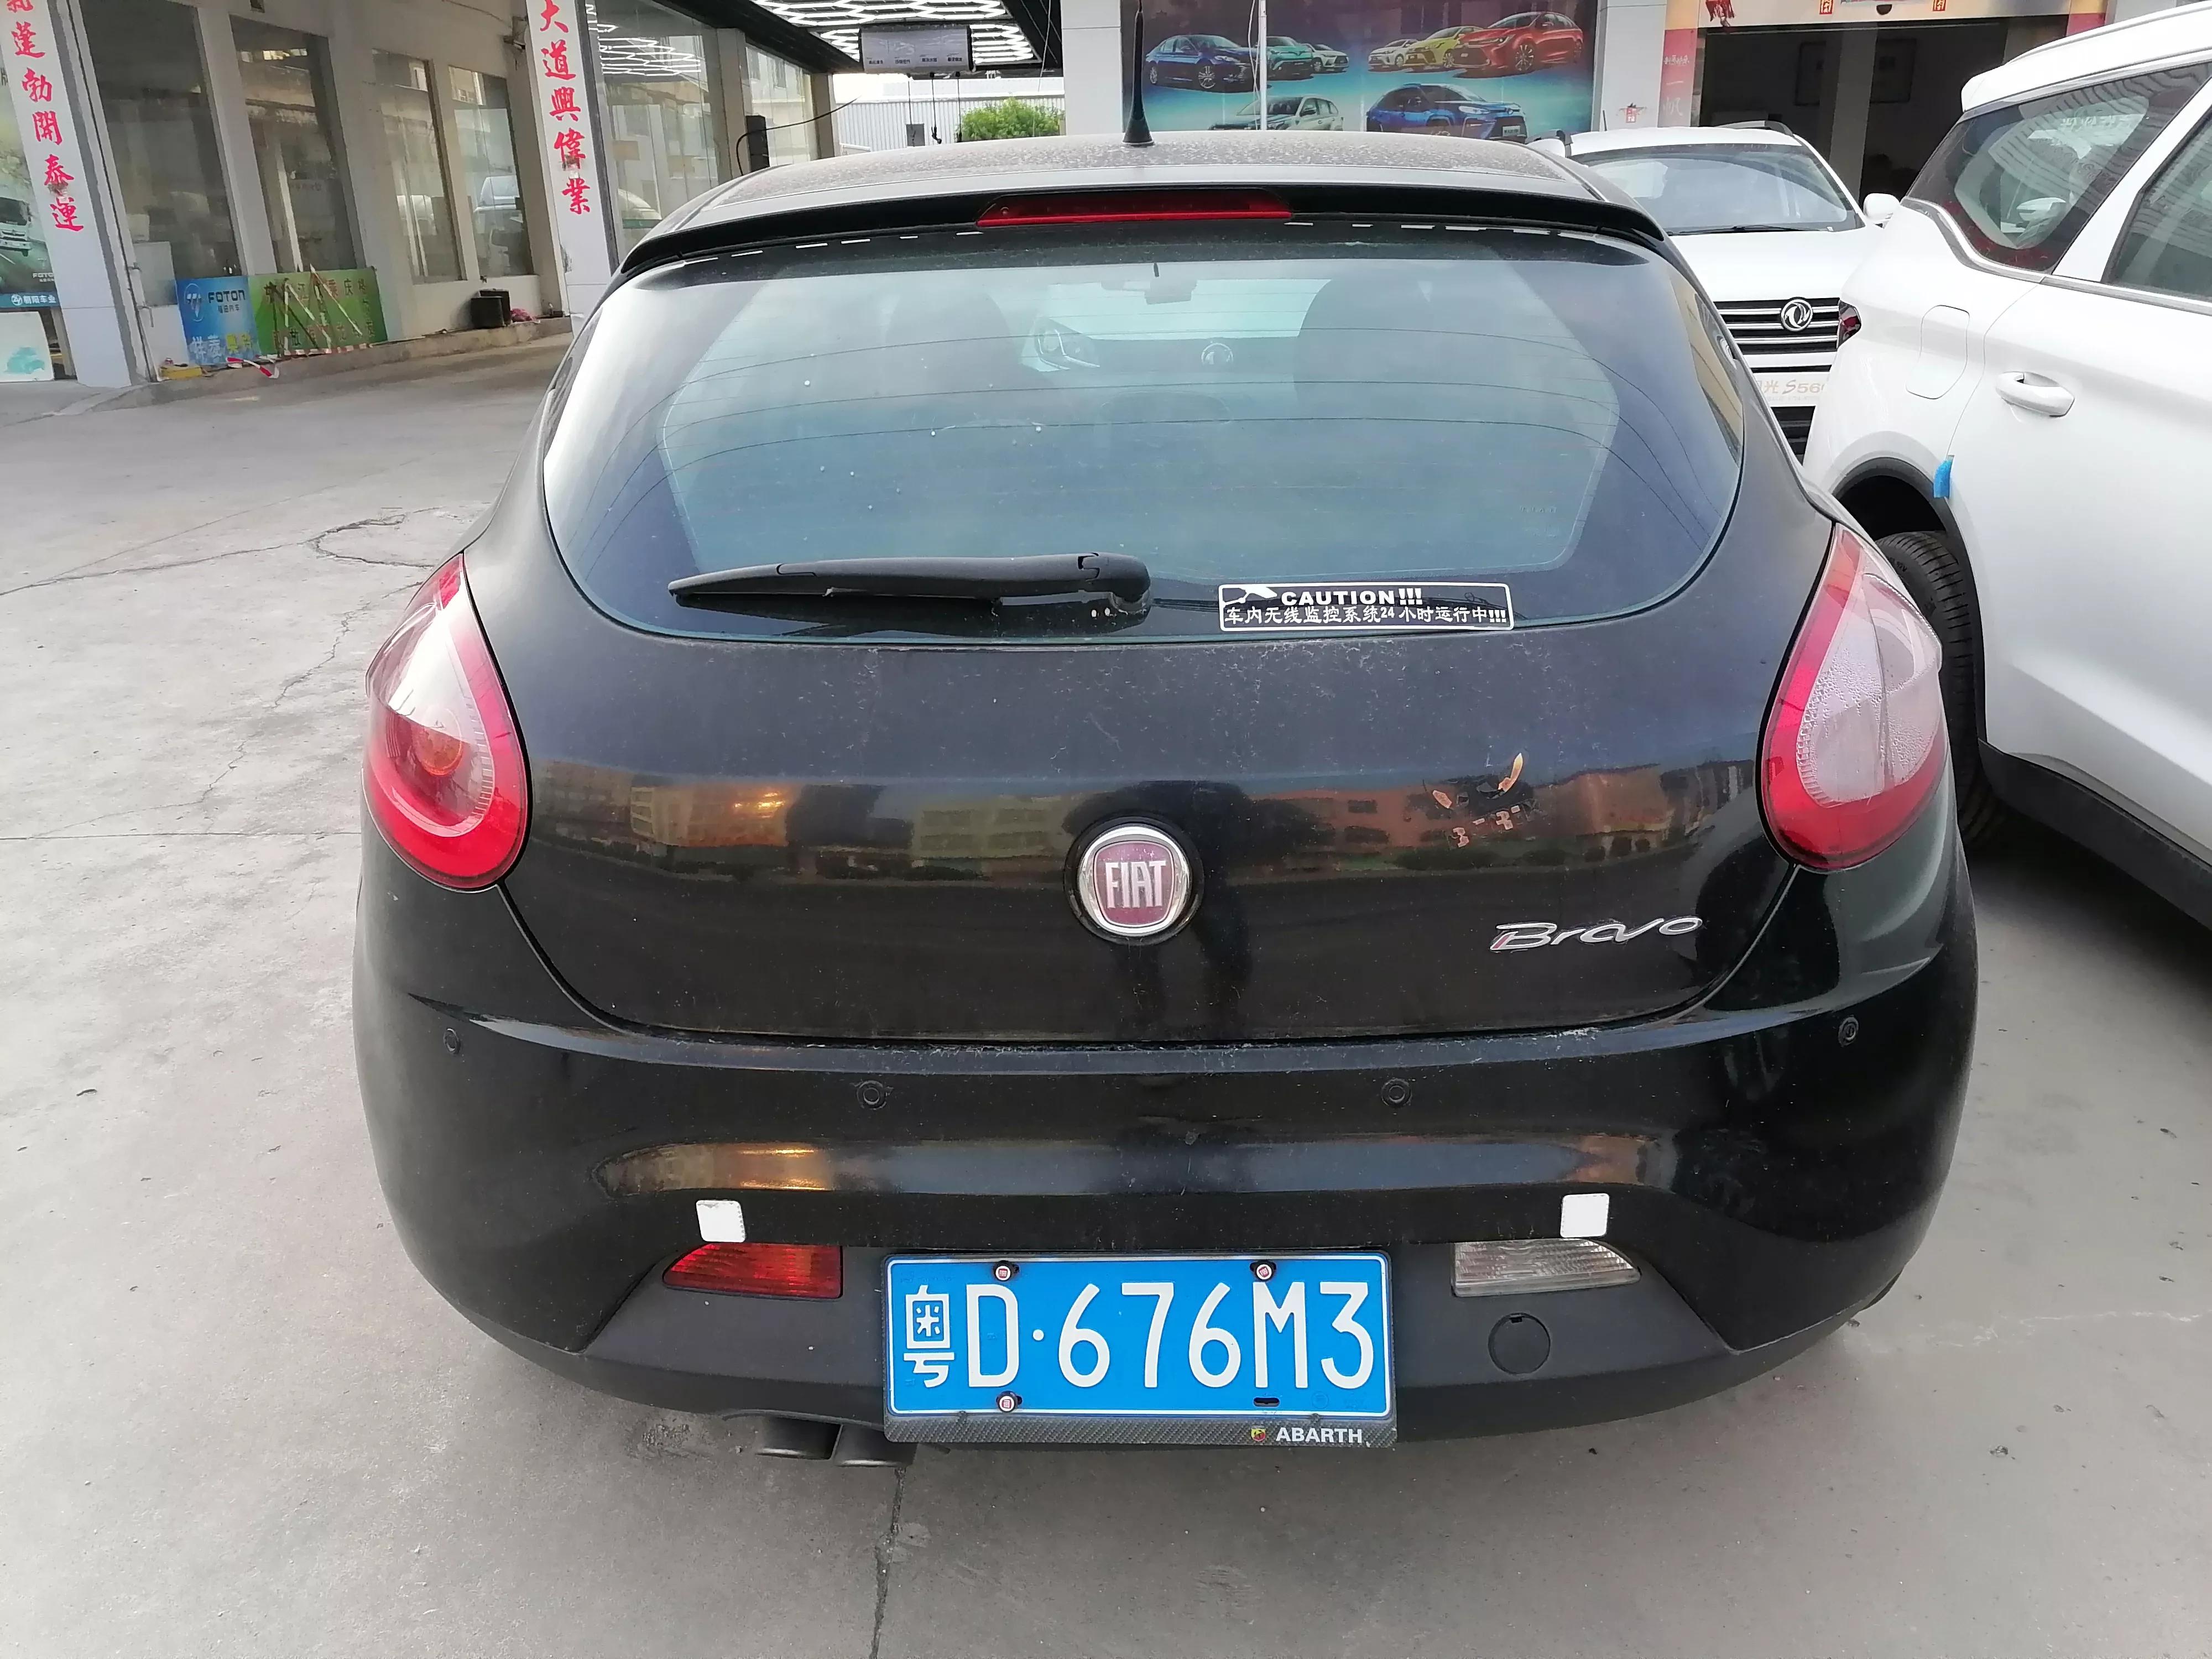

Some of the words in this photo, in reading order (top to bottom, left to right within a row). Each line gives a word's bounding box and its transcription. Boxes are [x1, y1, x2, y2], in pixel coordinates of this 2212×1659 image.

[208, 290, 246, 303] FOTON
[1782, 380, 1824, 394] S56
[1281, 588, 1423, 606] CAUTION!!!
[1105, 860, 1166, 909] FIAT
[1490, 917, 1703, 951] Bravo
[1275, 1427, 1362, 1443] ABARTH
